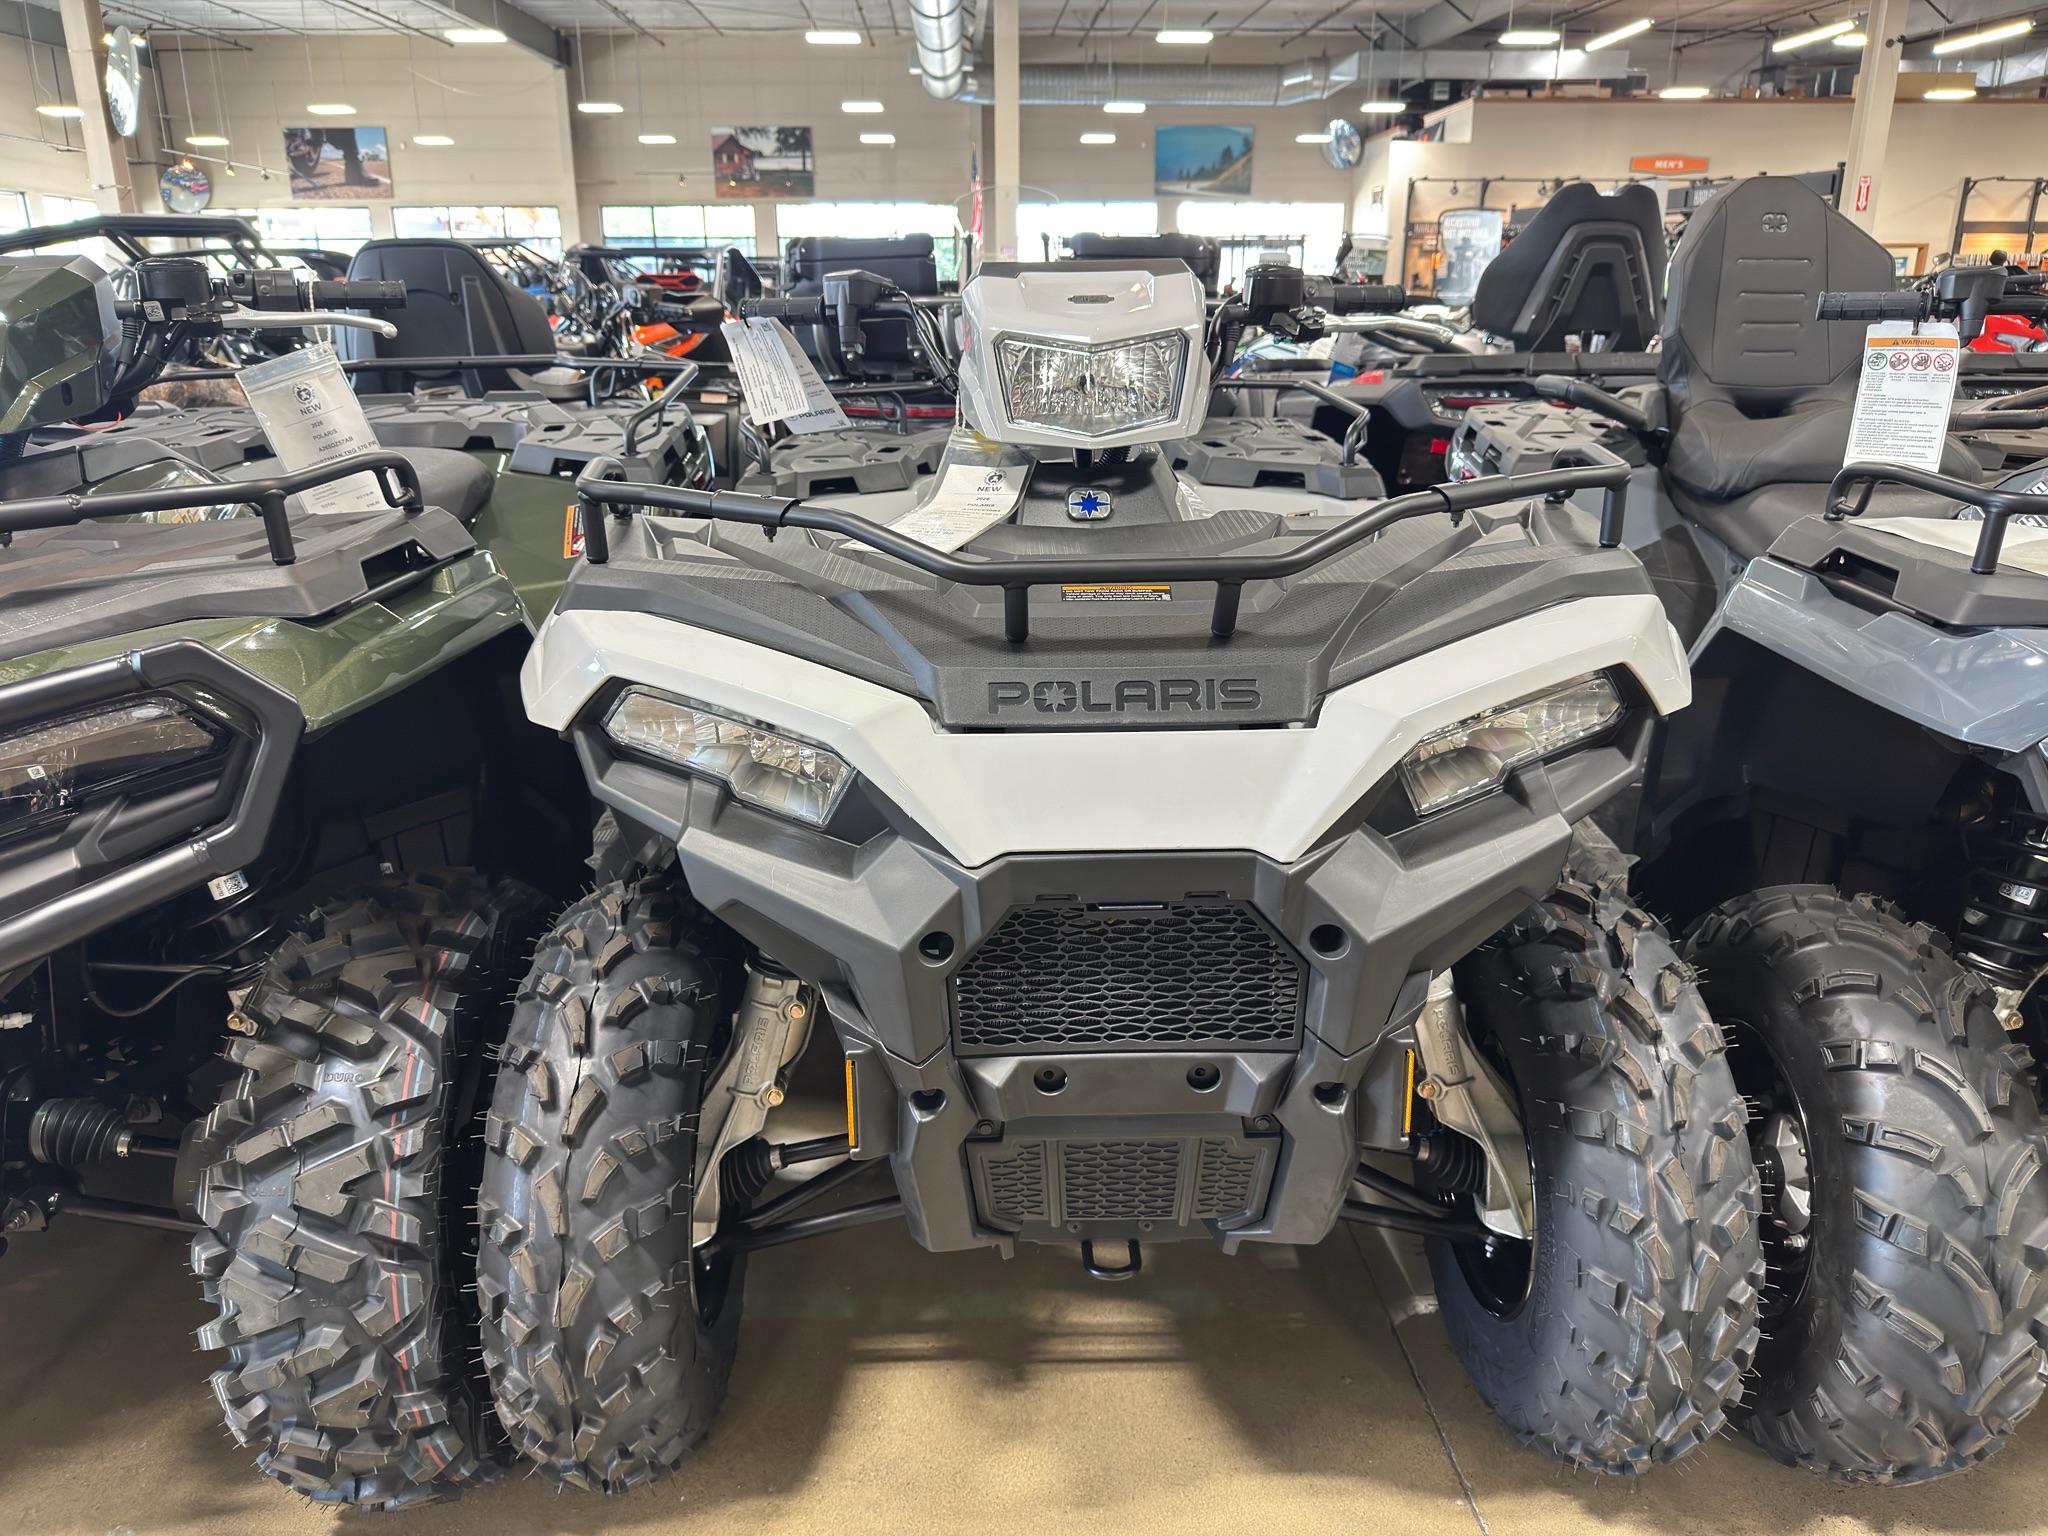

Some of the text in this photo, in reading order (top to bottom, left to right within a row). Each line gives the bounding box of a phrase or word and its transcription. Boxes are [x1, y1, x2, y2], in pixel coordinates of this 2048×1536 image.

[1654, 160, 1684, 169] MEN'S
[300, 403, 322, 416] NEW
[799, 408, 835, 418] POLARIS
[313, 429, 337, 441] POLARIS
[987, 679, 1262, 714] POLARIS
[1433, 1008, 1459, 1075] POLARIS
[743, 1016, 770, 1085] POLARIS
[323, 1072, 365, 1082] DURO
